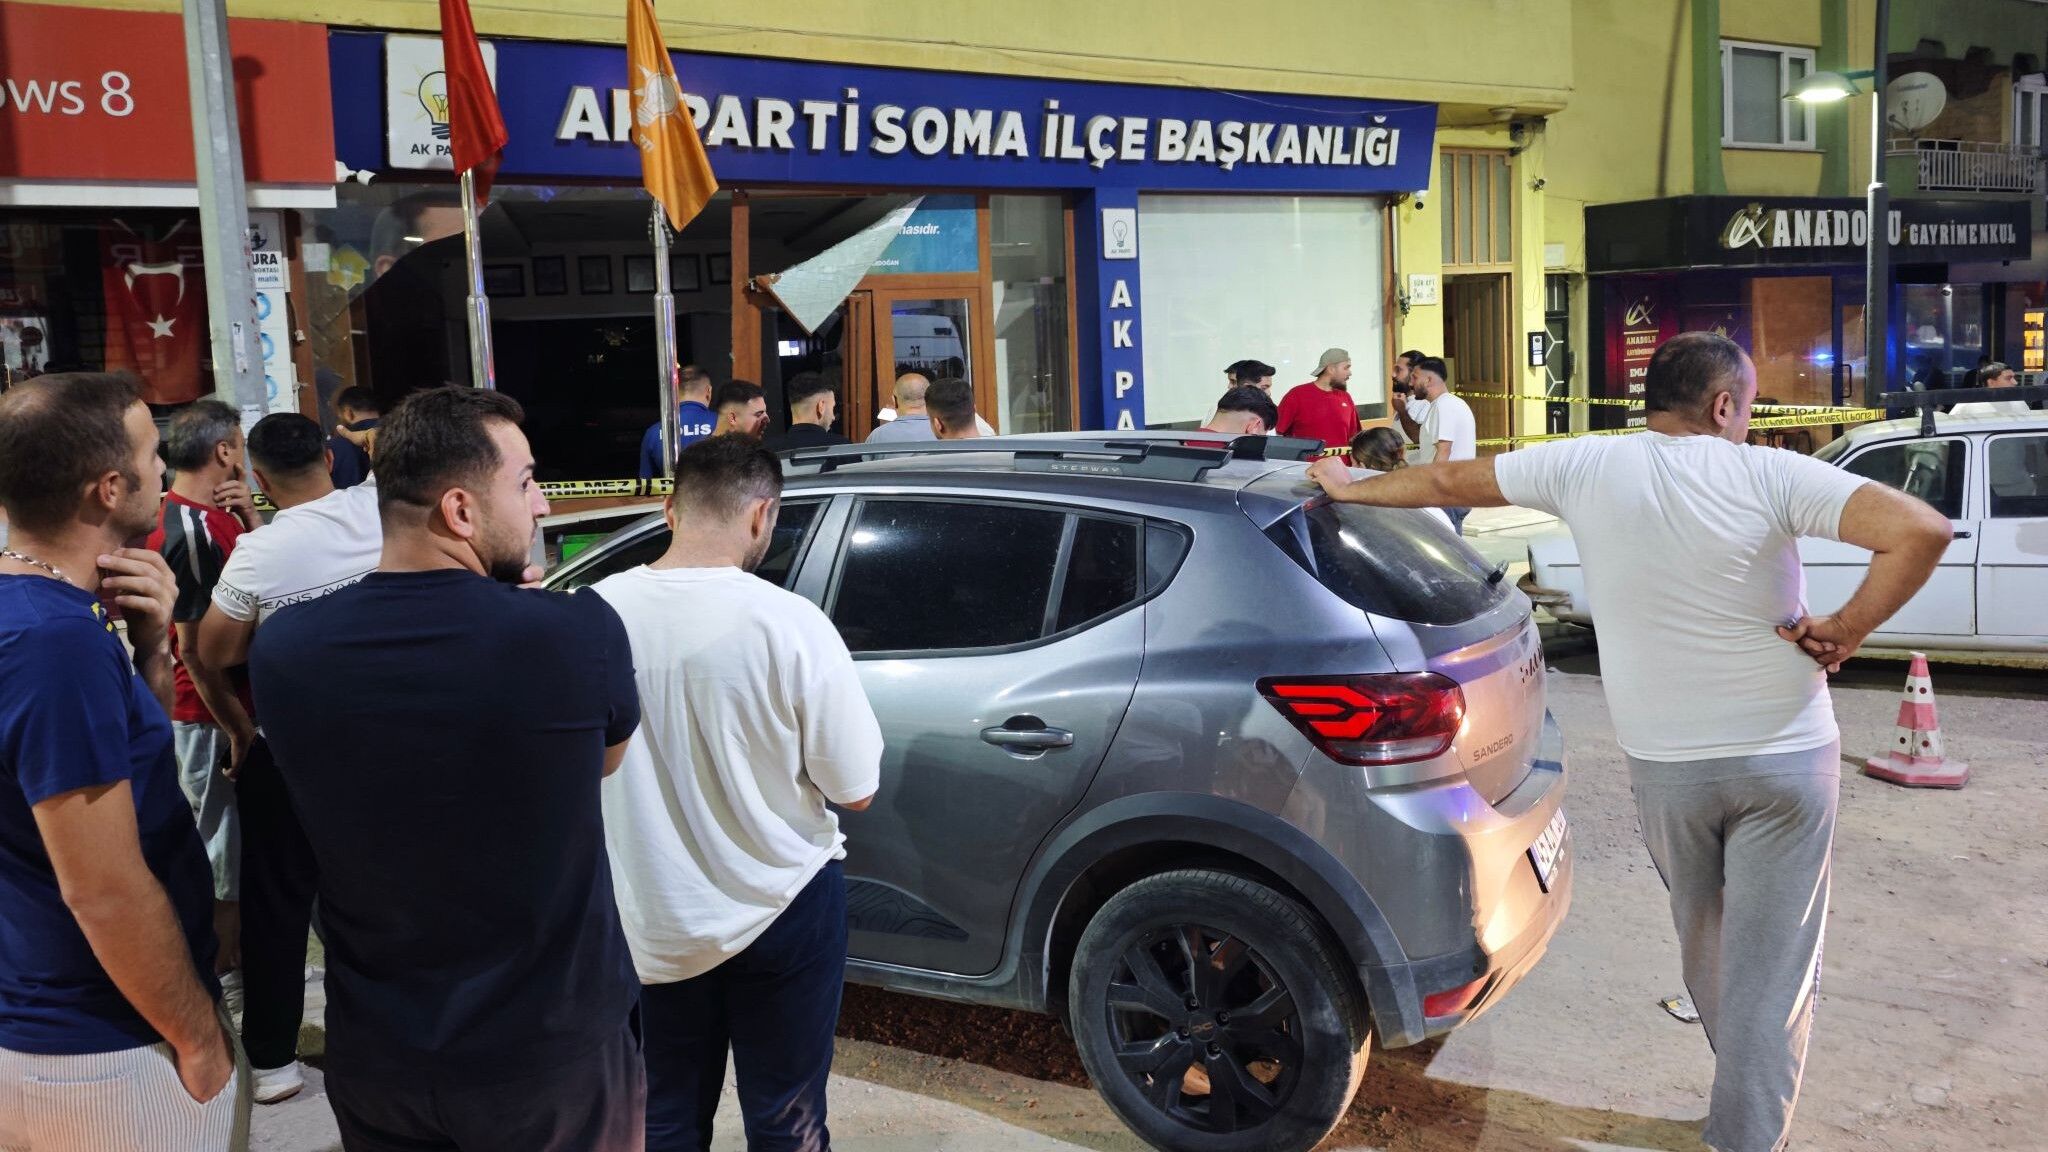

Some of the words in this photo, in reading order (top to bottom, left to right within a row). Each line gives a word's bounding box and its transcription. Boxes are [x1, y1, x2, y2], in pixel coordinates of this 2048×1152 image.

[100, 70, 135, 117] 8
[682, 87, 859, 151] PARTİ
[870, 105, 1028, 158] SOMA
[1042, 99, 1149, 169] İLÇE
[1156, 115, 1400, 171] BAŞKANLIĞI
[411, 143, 431, 155] AK
[1773, 209, 1902, 247] ANADOU
[1909, 219, 2016, 246] GAYRİMENKUL
[252, 253, 279, 266] URA
[873, 259, 900, 267] DOĞAN
[217, 582, 251, 606] EANS
[1473, 733, 1514, 762] SANDERO
